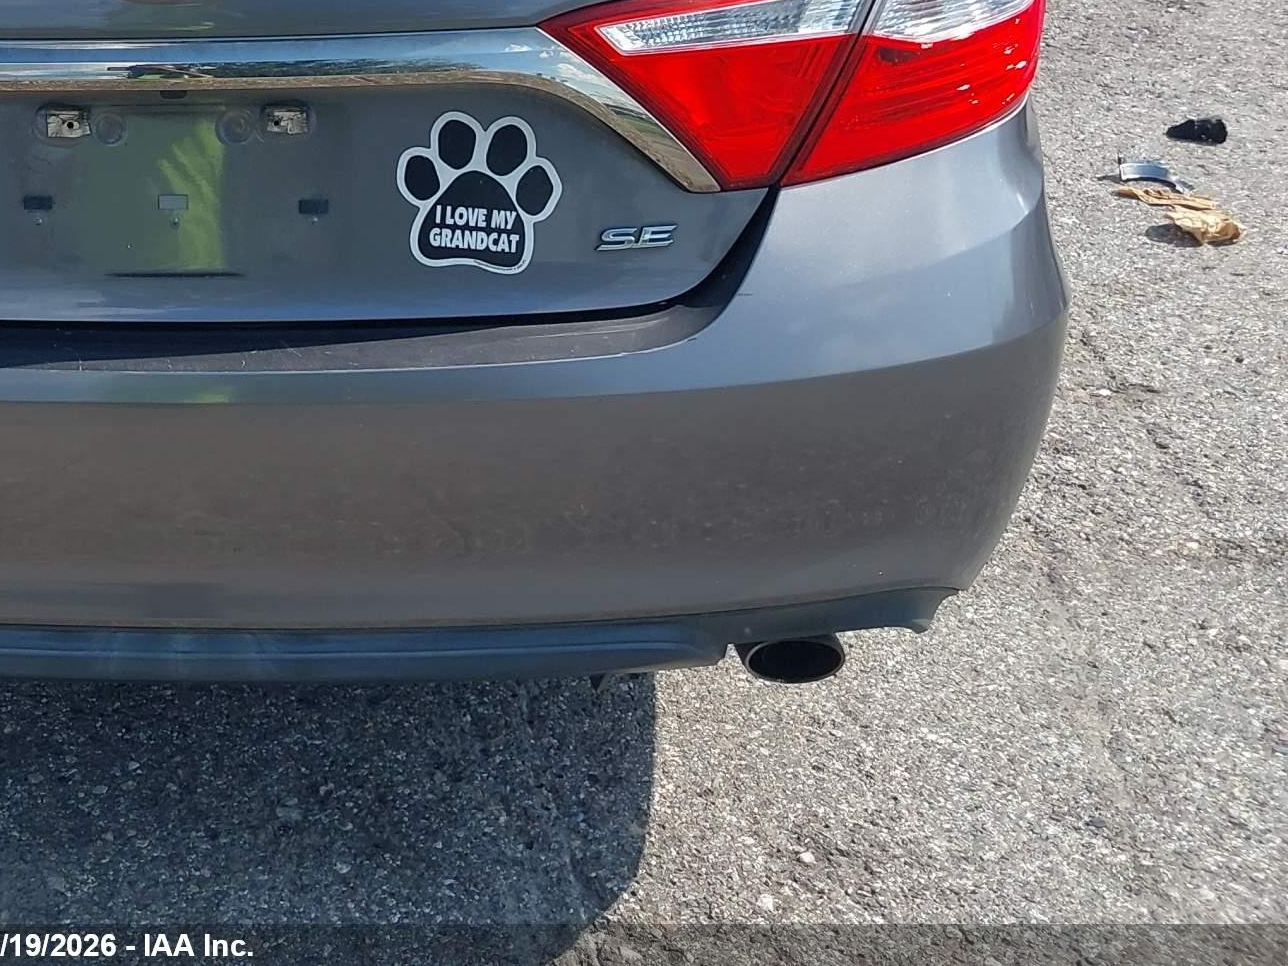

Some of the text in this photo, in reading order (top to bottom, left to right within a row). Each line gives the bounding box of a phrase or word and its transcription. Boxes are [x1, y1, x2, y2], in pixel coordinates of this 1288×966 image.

[435, 205, 517, 230] I LOVE MY
[429, 227, 520, 253] GRANDCAT
[596, 225, 678, 251] SE
